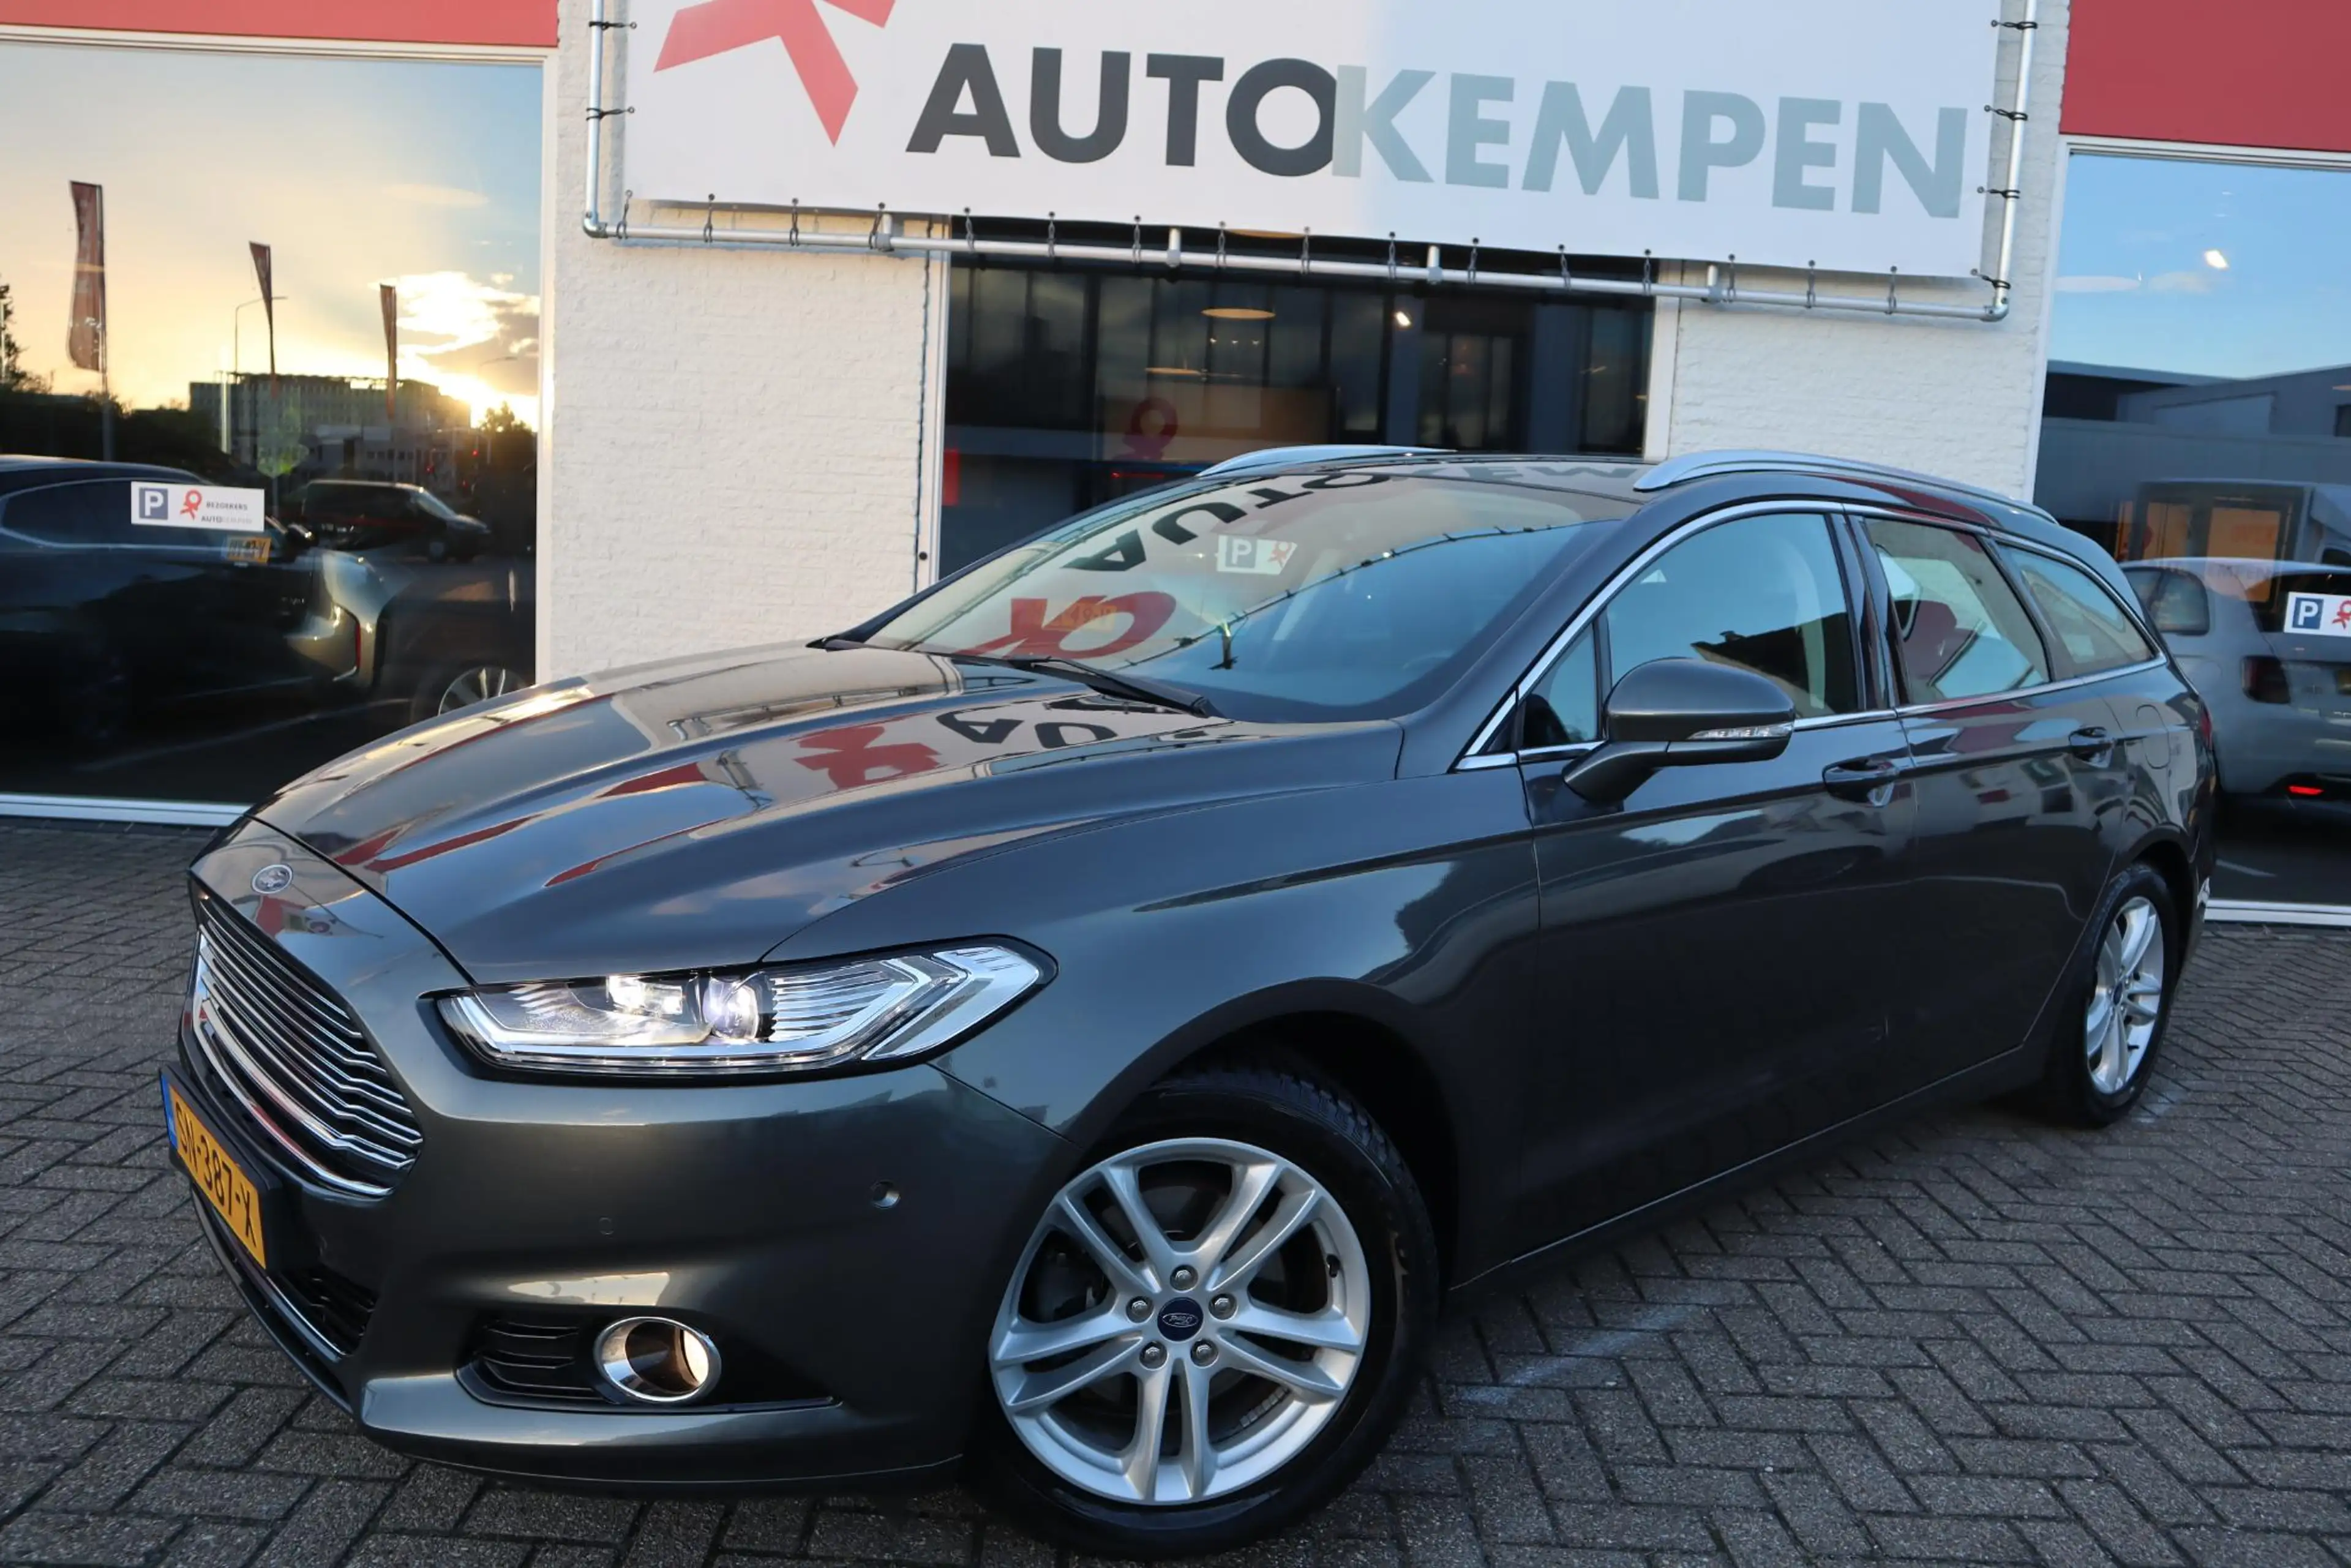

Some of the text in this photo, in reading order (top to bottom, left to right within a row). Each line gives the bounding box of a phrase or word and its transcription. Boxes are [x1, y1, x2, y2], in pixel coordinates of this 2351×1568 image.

[906, 42, 1967, 219] AUTOKEMPEN
[144, 490, 163, 517] P
[1231, 539, 1252, 565] P
[2298, 600, 2319, 626] P
[175, 1101, 257, 1247] SN-387-X
